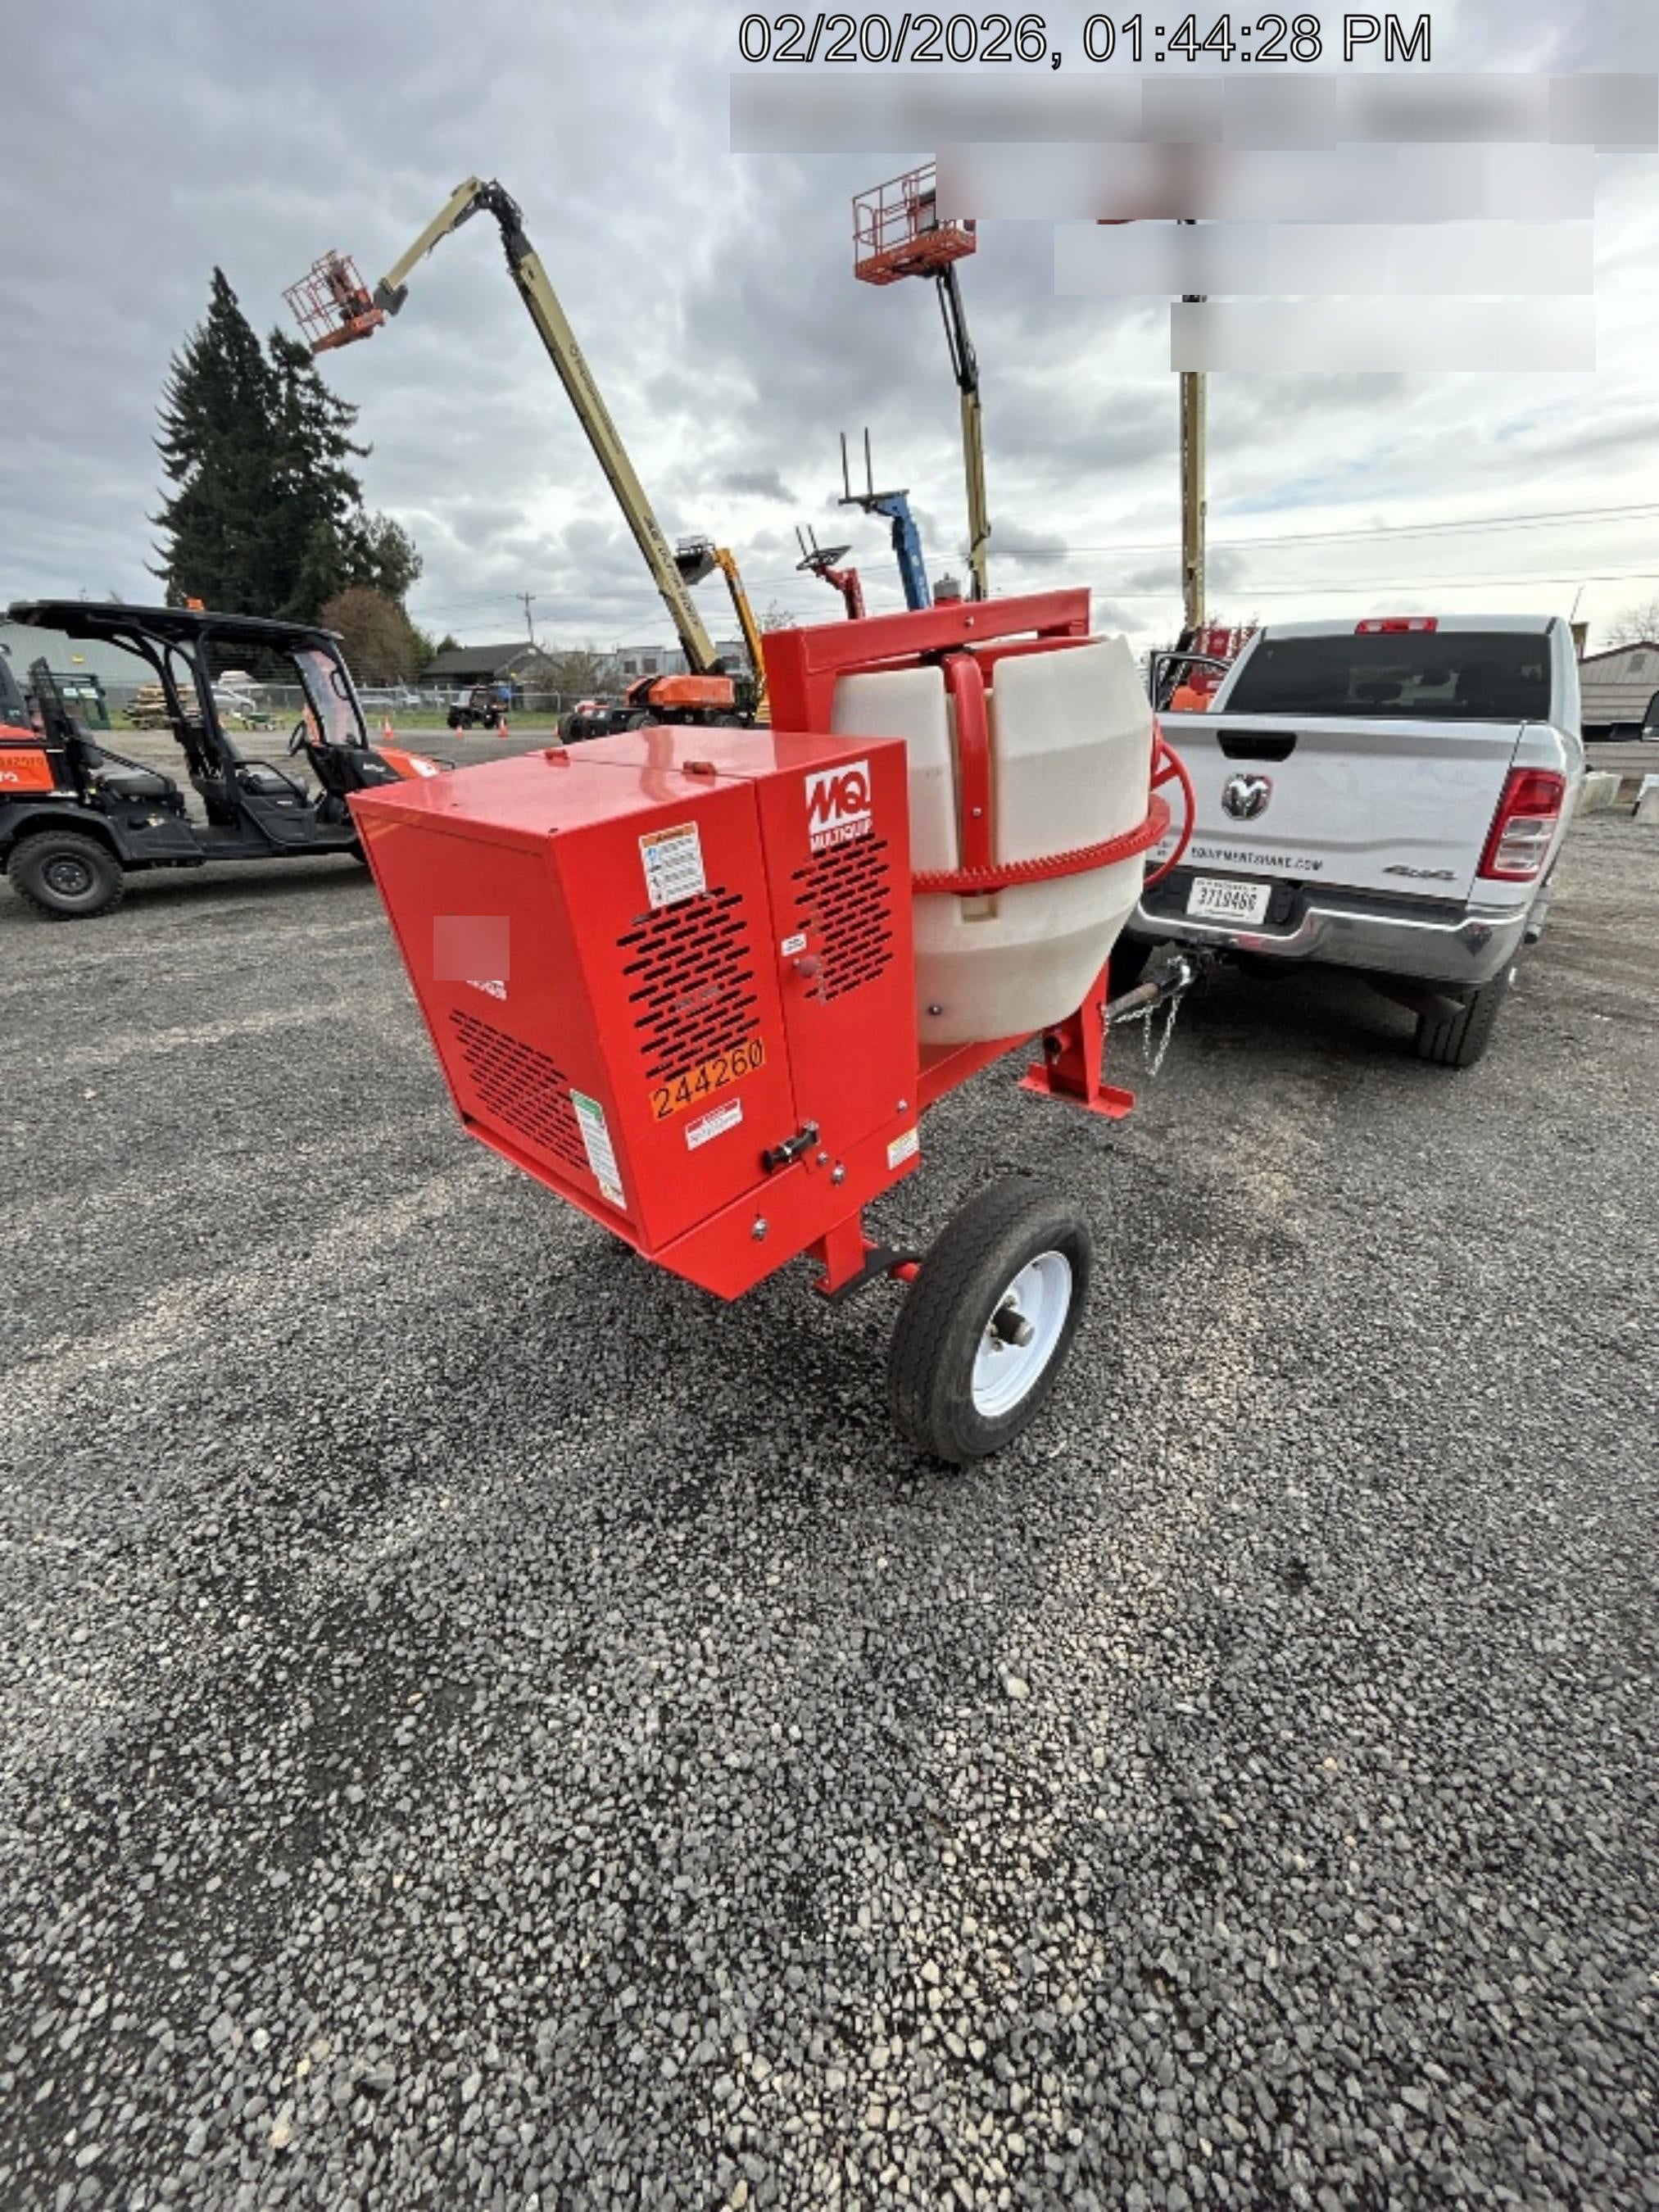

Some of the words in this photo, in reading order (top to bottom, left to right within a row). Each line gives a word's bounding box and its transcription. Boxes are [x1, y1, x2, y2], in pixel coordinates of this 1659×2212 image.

[806, 771, 871, 824] MQ
[810, 818, 873, 853] MULTIQUIP
[654, 1039, 764, 1119] 244260
